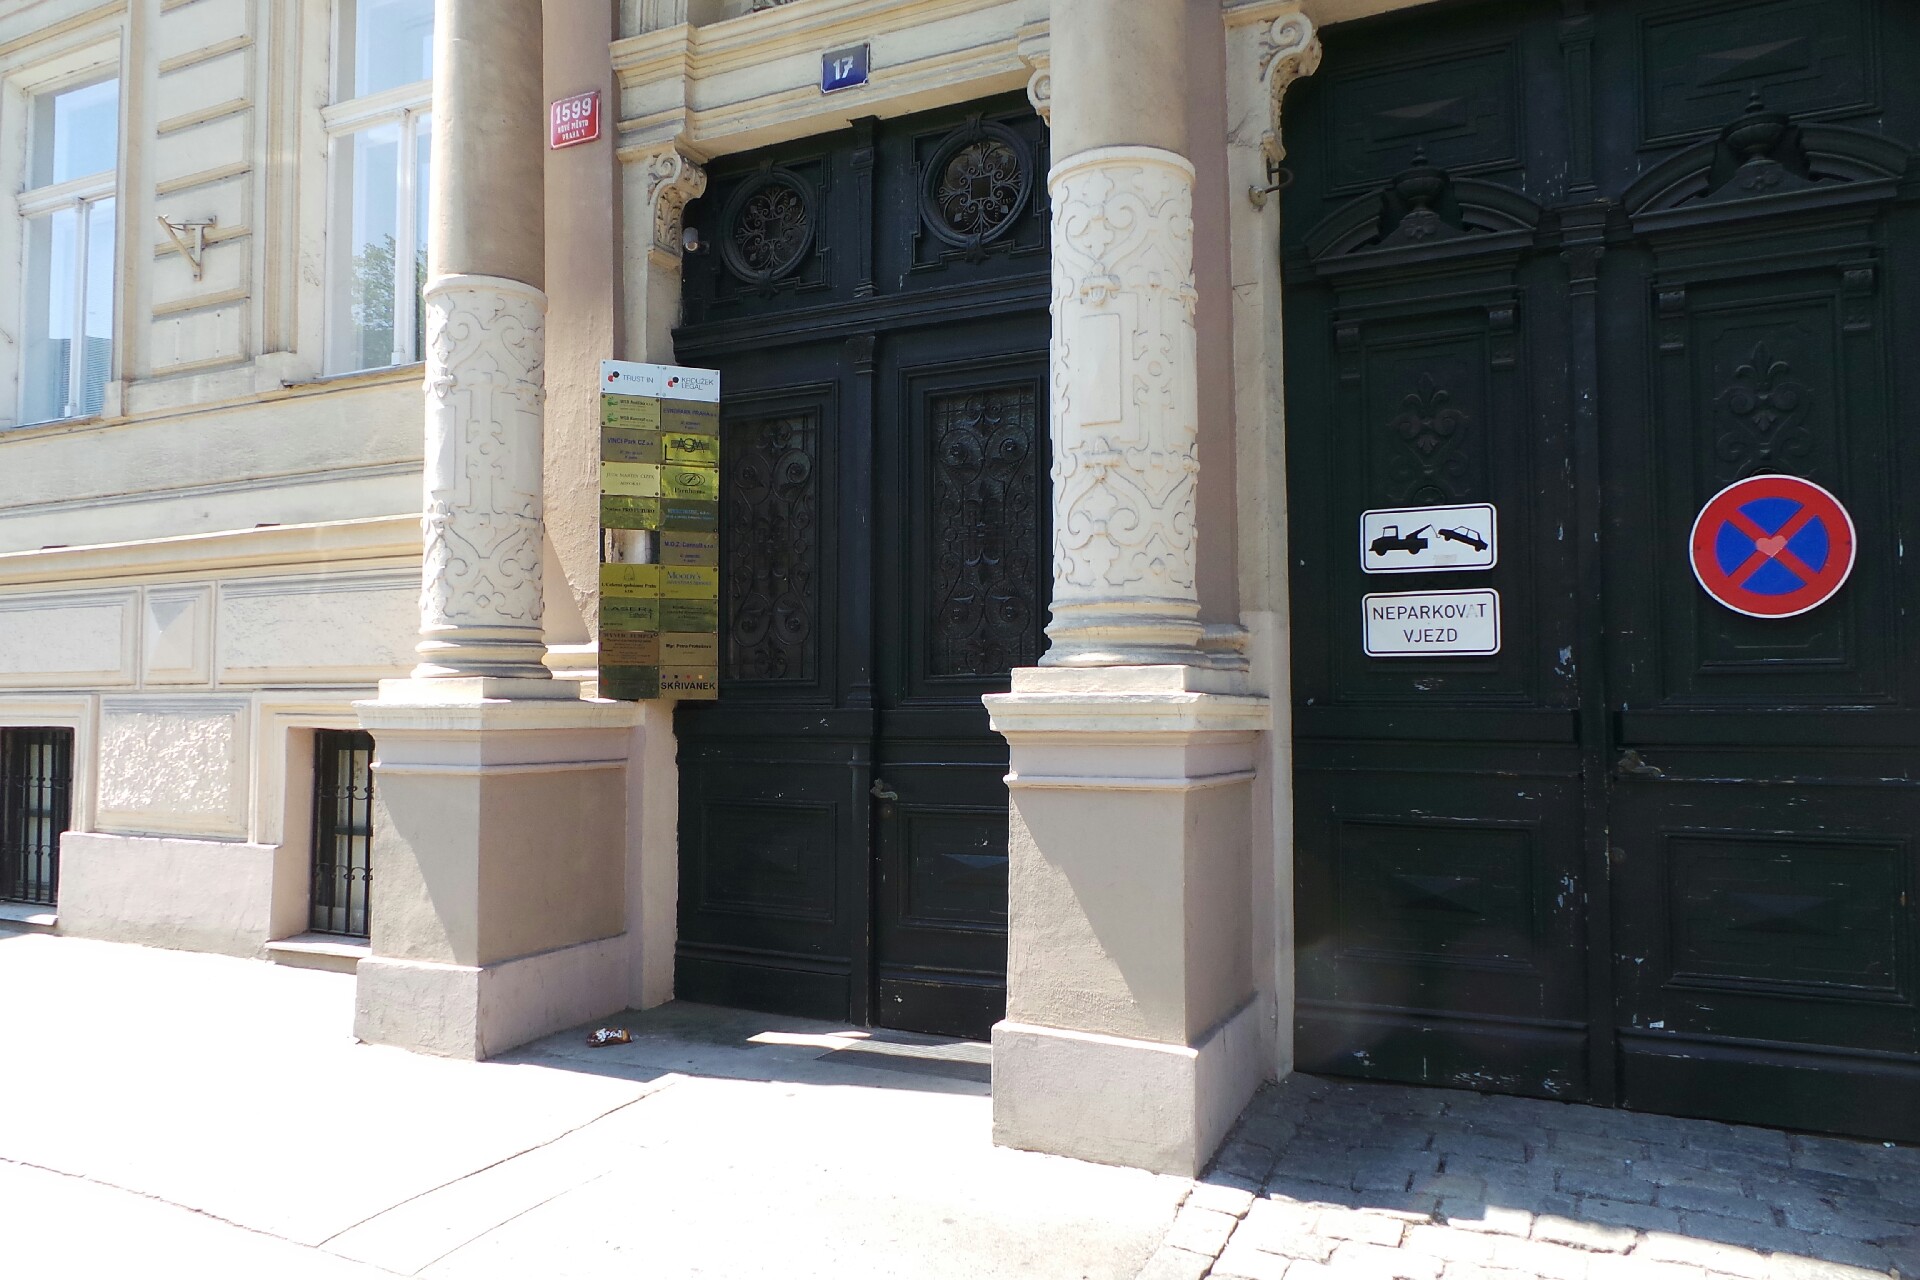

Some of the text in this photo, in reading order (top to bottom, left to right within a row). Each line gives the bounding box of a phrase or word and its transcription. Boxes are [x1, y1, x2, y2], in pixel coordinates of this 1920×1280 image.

[833, 55, 854, 81] 17
[555, 97, 592, 125] 1599
[562, 130, 580, 141] PRAHA
[623, 374, 654, 384] TRUST IN
[681, 383, 703, 391] LEGAL
[1372, 603, 1487, 620] NEPARKOVAT
[1403, 628, 1458, 643] VJEZD
